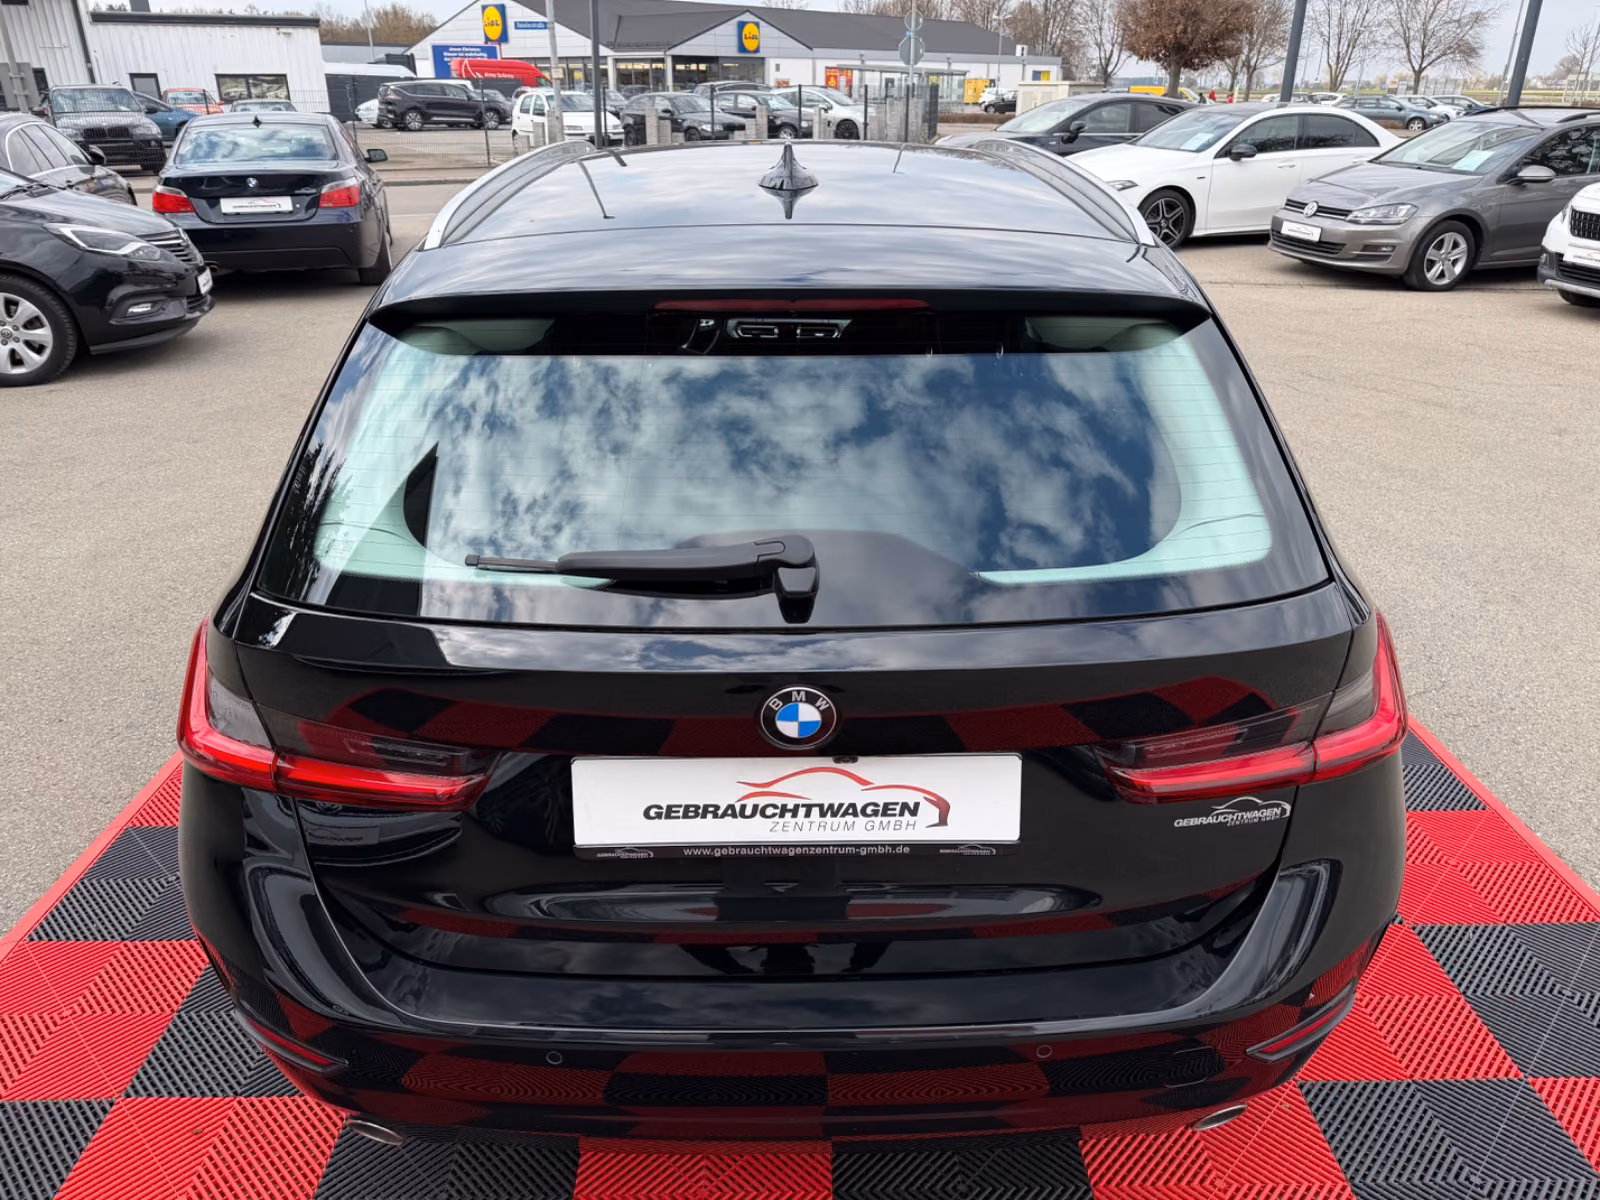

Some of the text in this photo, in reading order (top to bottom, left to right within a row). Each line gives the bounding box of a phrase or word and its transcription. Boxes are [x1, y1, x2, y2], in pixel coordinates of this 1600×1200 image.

[769, 690, 830, 711] BMW
[642, 801, 920, 820] GEBRAUCHTWAGEN
[1174, 807, 1282, 827] GEBRAUCHTWAGEN
[769, 820, 917, 832] ZENTRUM GMBH
[1227, 817, 1259, 826] ZENTRUM
[685, 846, 910, 857] www.gebrauchtwagenzentrum-gmbh.de
